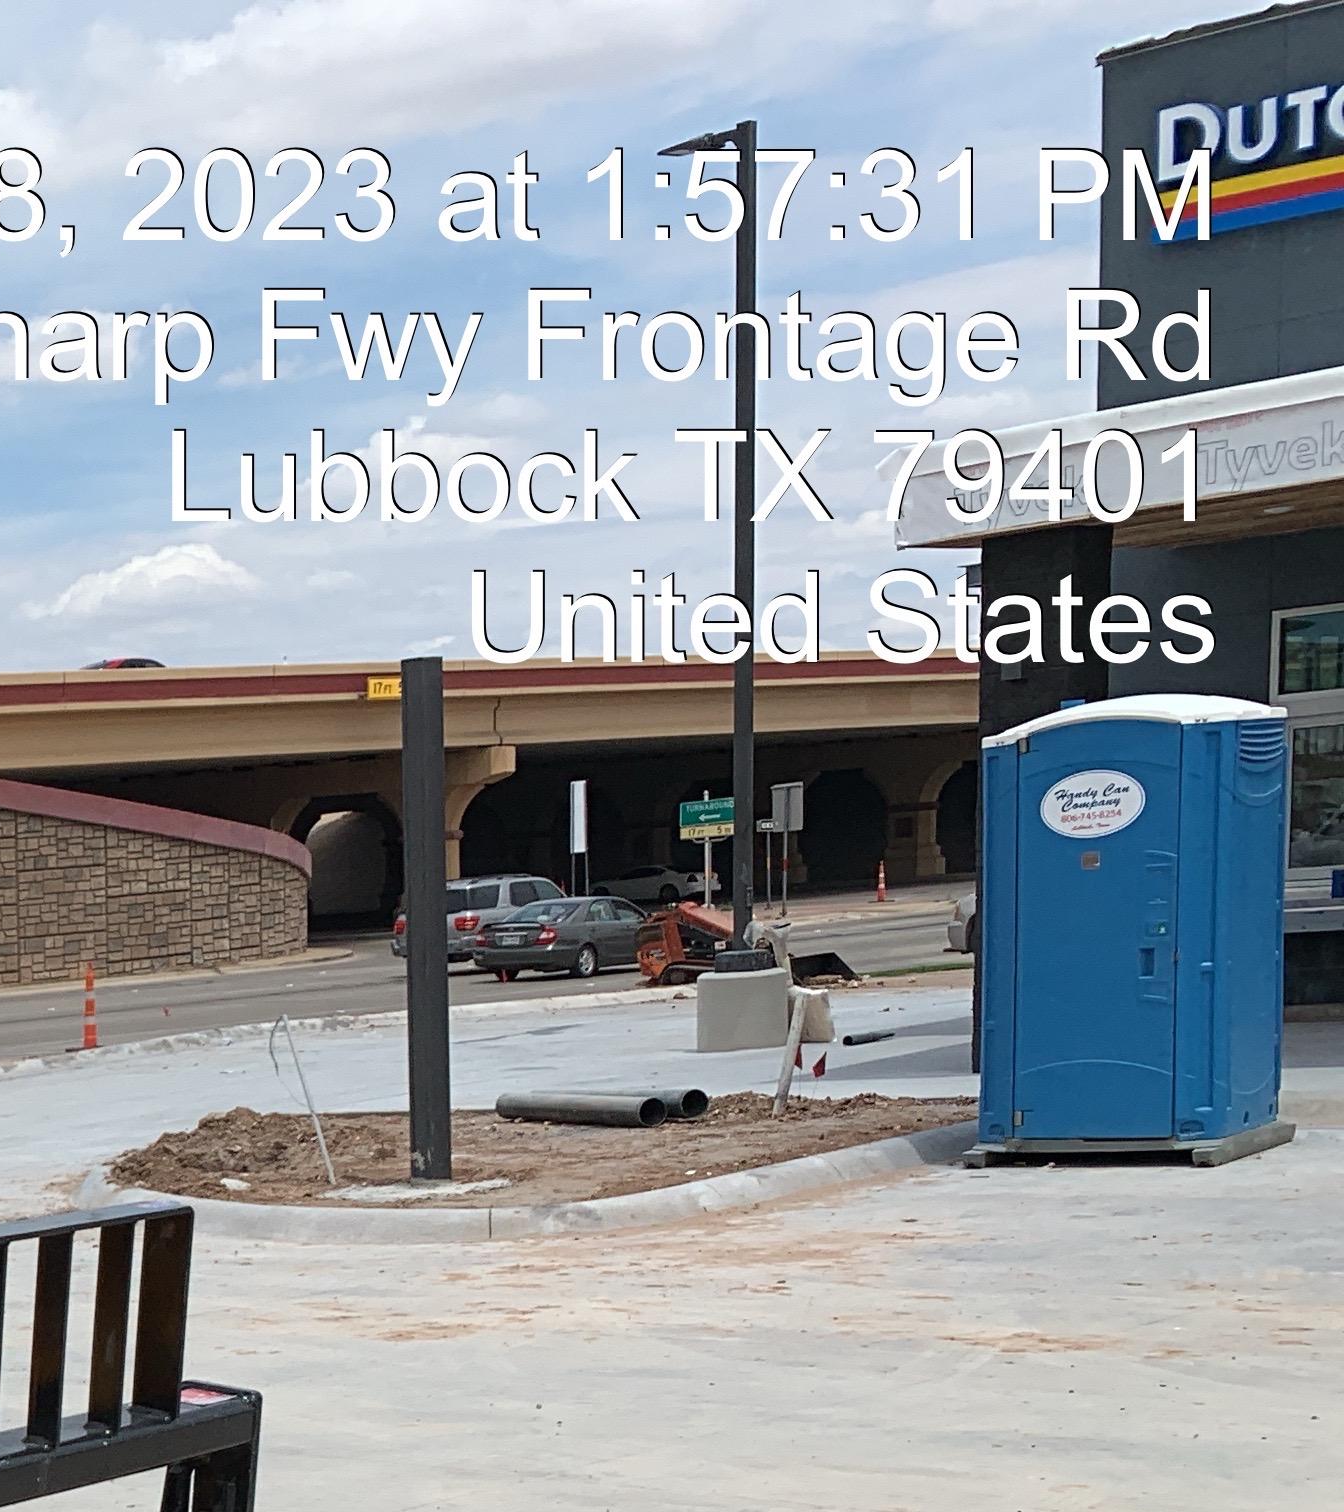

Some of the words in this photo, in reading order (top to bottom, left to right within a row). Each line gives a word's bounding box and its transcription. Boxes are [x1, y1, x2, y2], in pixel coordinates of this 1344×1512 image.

[1054, 787, 1098, 801] Handy
[1103, 783, 1130, 797] Can
[686, 800, 735, 813] TURNAROUND
[1061, 797, 1121, 812] Company
